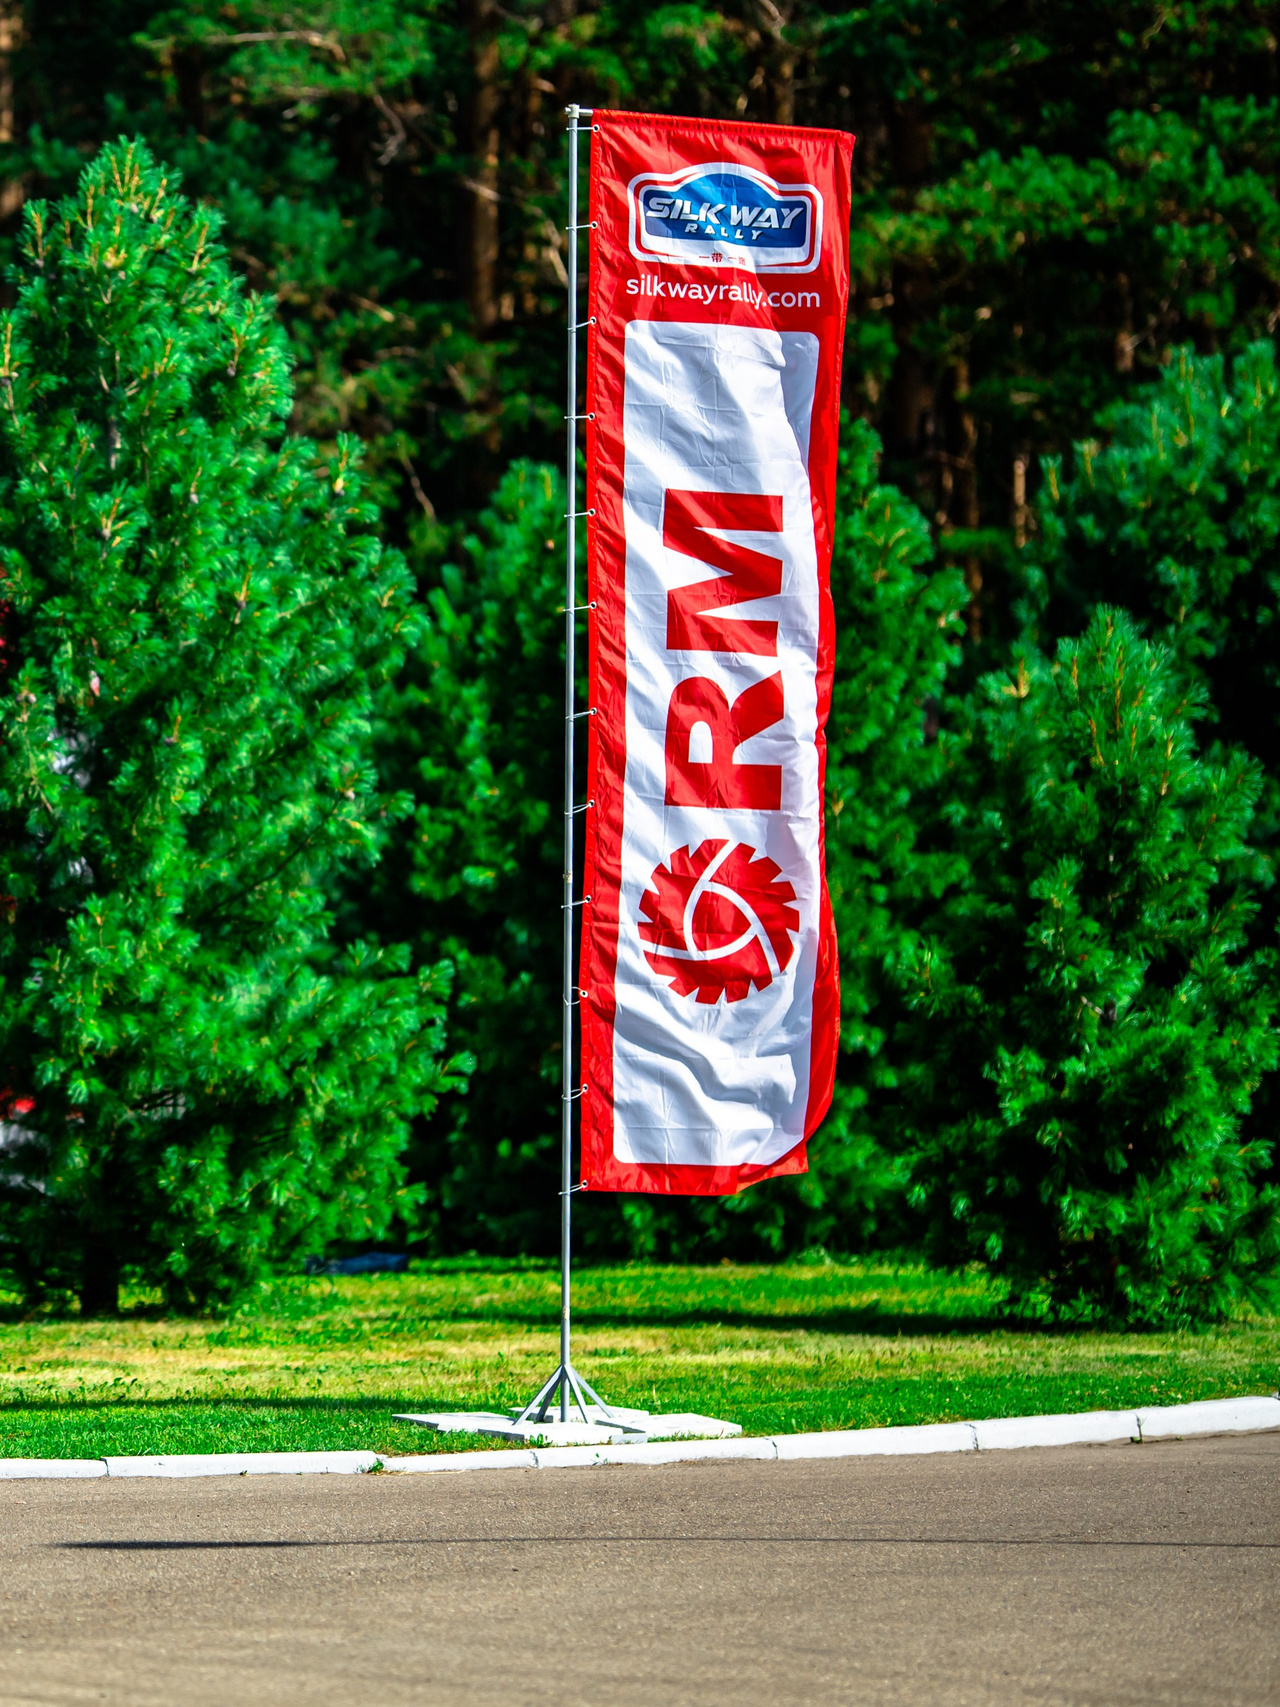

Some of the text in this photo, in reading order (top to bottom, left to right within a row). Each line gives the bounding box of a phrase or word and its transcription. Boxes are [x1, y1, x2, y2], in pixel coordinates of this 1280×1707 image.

[646, 197, 804, 229] SILK WAY
[684, 222, 763, 240] RALLY
[626, 274, 821, 309] silkwayrally.com
[663, 488, 785, 811] RM
